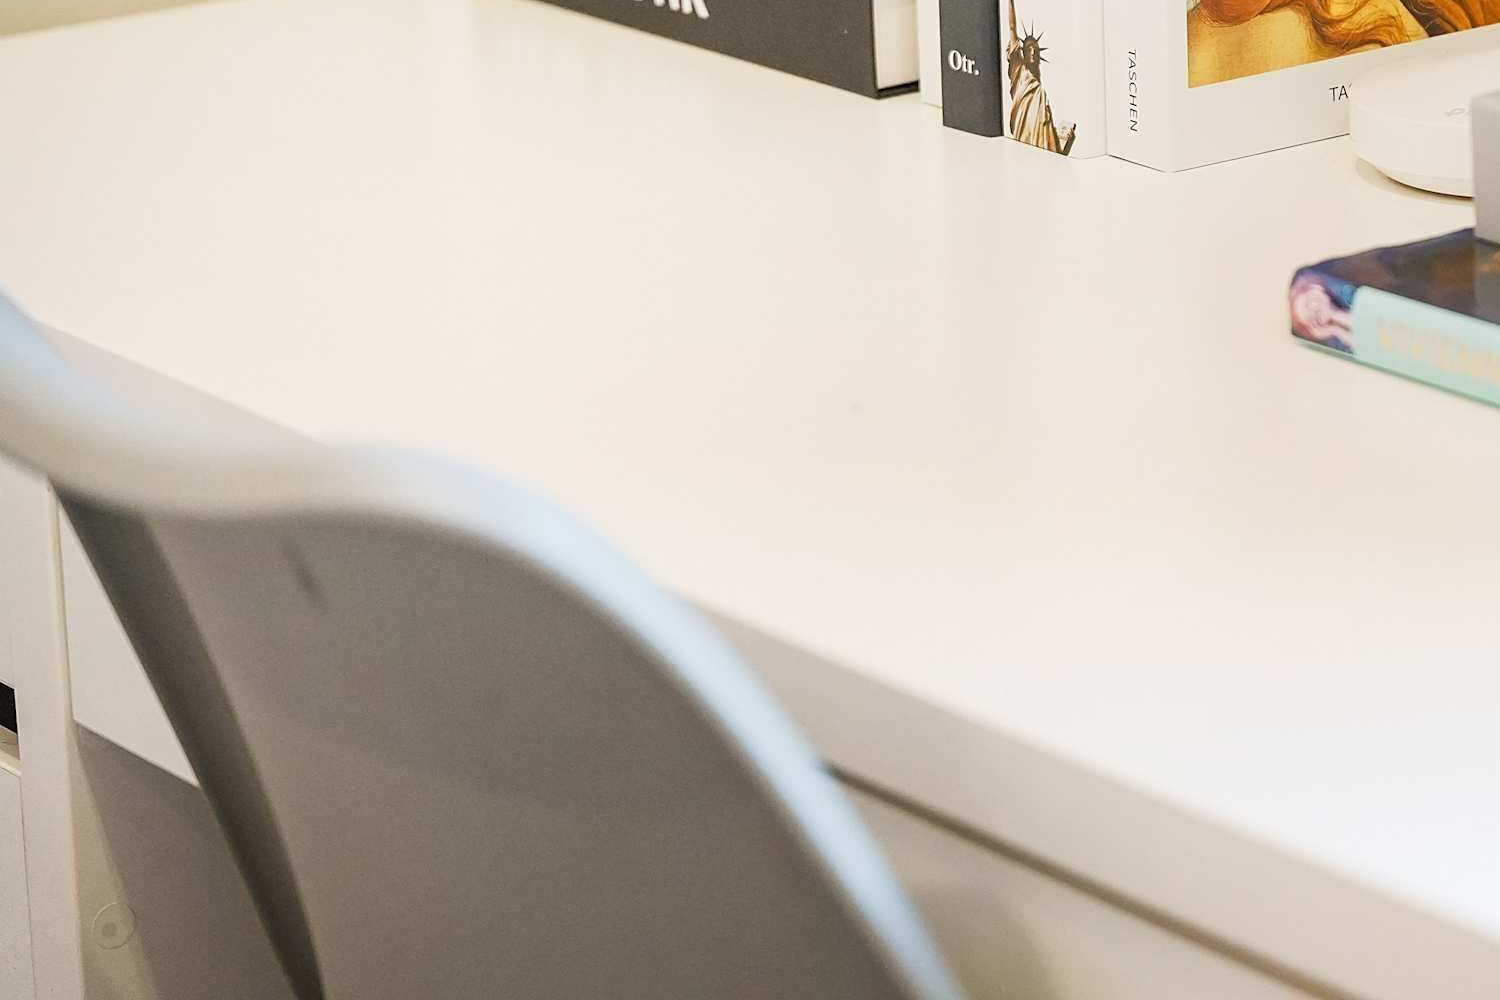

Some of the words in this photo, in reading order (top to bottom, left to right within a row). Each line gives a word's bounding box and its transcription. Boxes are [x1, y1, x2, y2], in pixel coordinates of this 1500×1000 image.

[947, 49, 980, 76] Otr.
[1128, 49, 1138, 132] TASCHEN
[1329, 83, 1352, 102] TA
